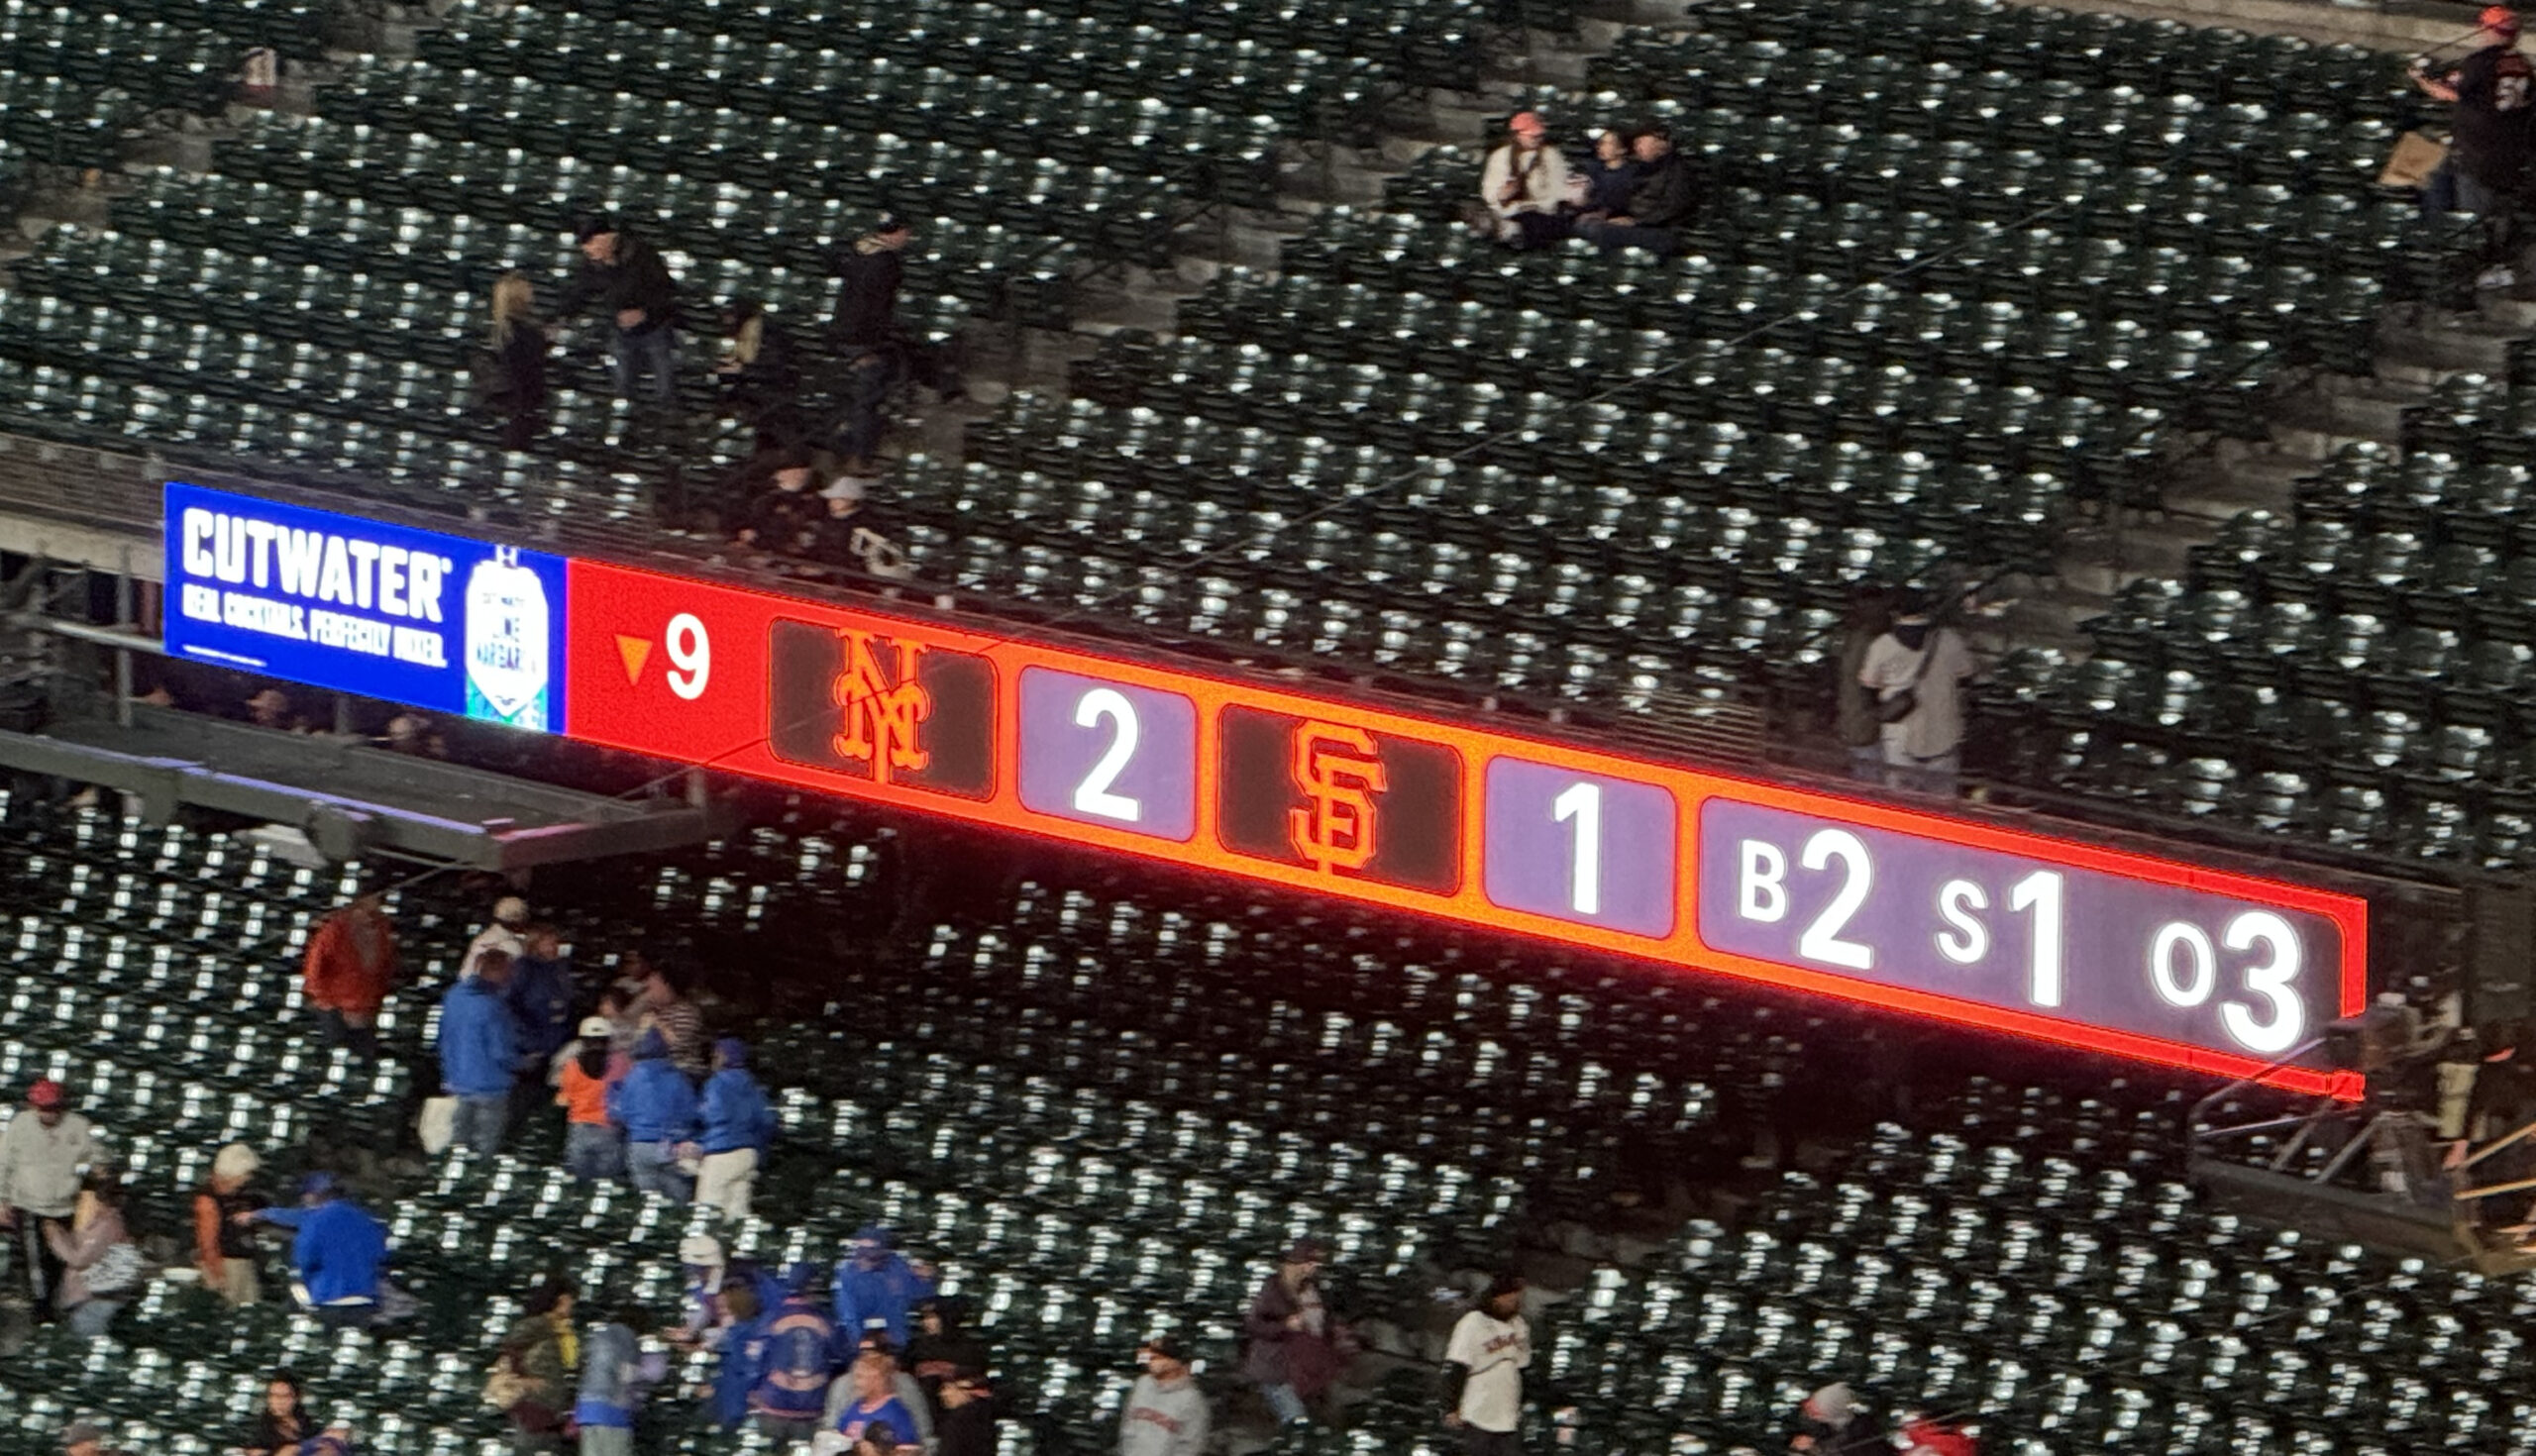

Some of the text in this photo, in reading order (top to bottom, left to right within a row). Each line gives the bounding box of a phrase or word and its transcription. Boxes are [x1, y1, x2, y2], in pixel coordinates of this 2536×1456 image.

[182, 507, 443, 623] CUTWATER
[667, 613, 709, 699] 9
[1074, 687, 1139, 822] 2
[1553, 781, 1600, 914] 1
[1740, 828, 2303, 1053] B 2 S 1 O 3
